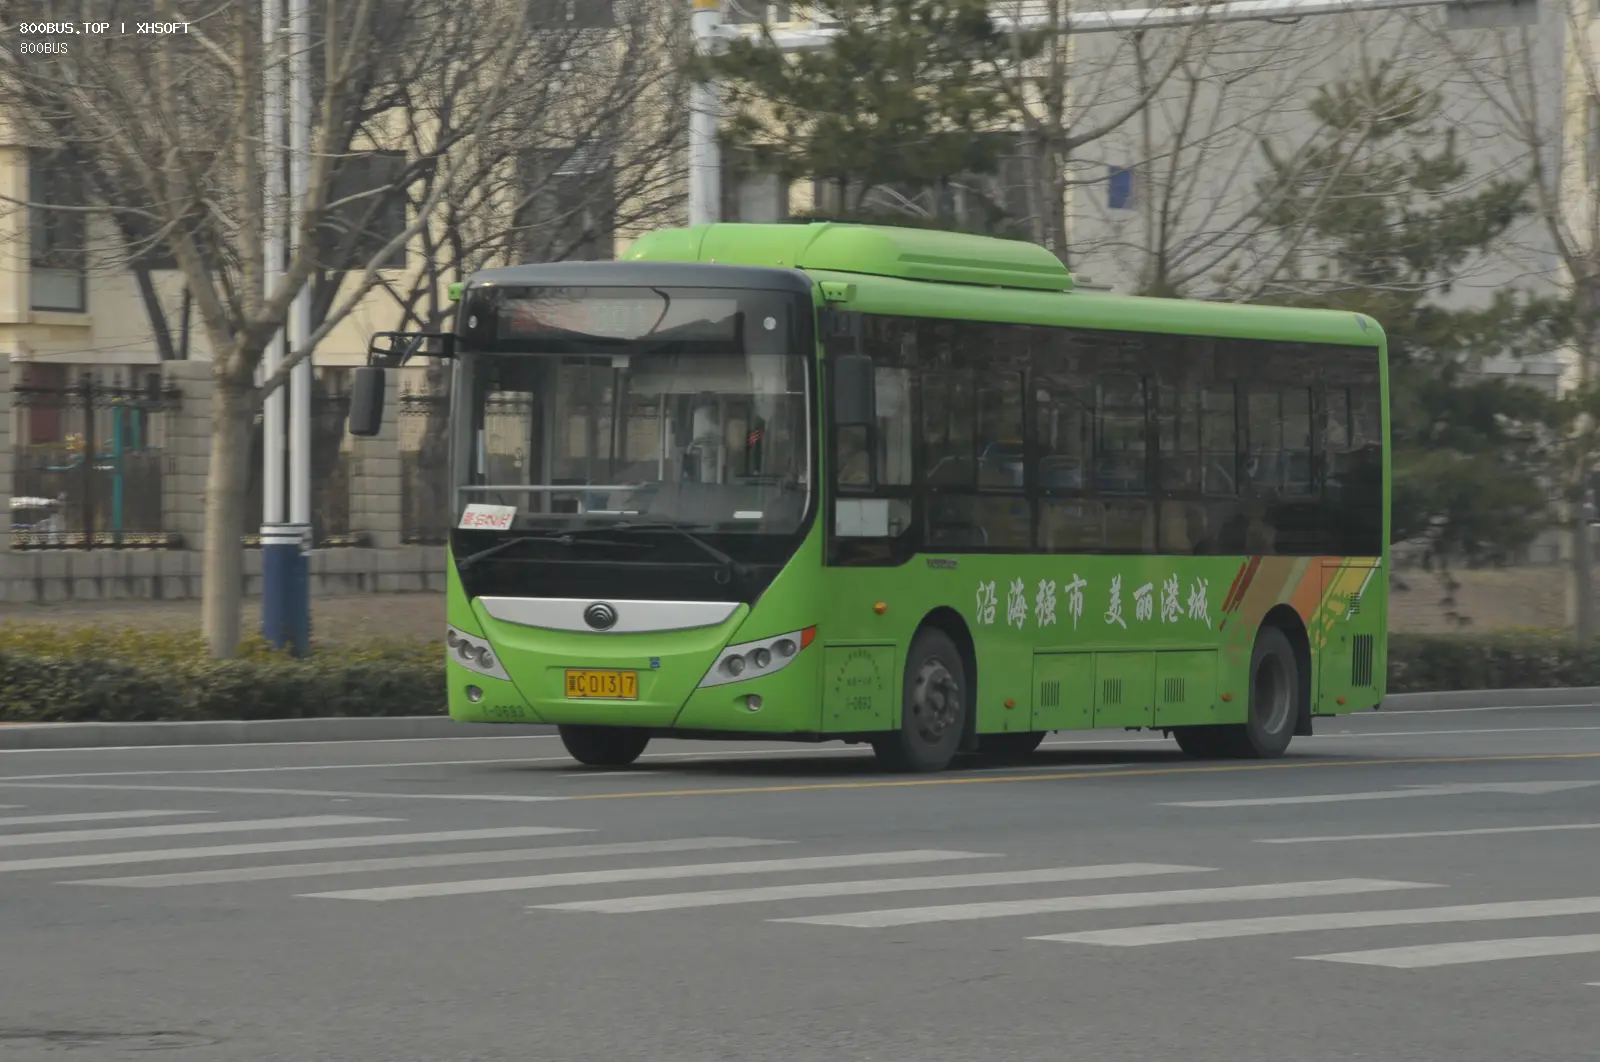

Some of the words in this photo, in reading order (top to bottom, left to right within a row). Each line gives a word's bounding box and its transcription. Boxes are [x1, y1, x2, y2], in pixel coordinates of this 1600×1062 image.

[976, 573, 1088, 630] 沿海强市
[1104, 573, 1212, 630] 美丽港城
